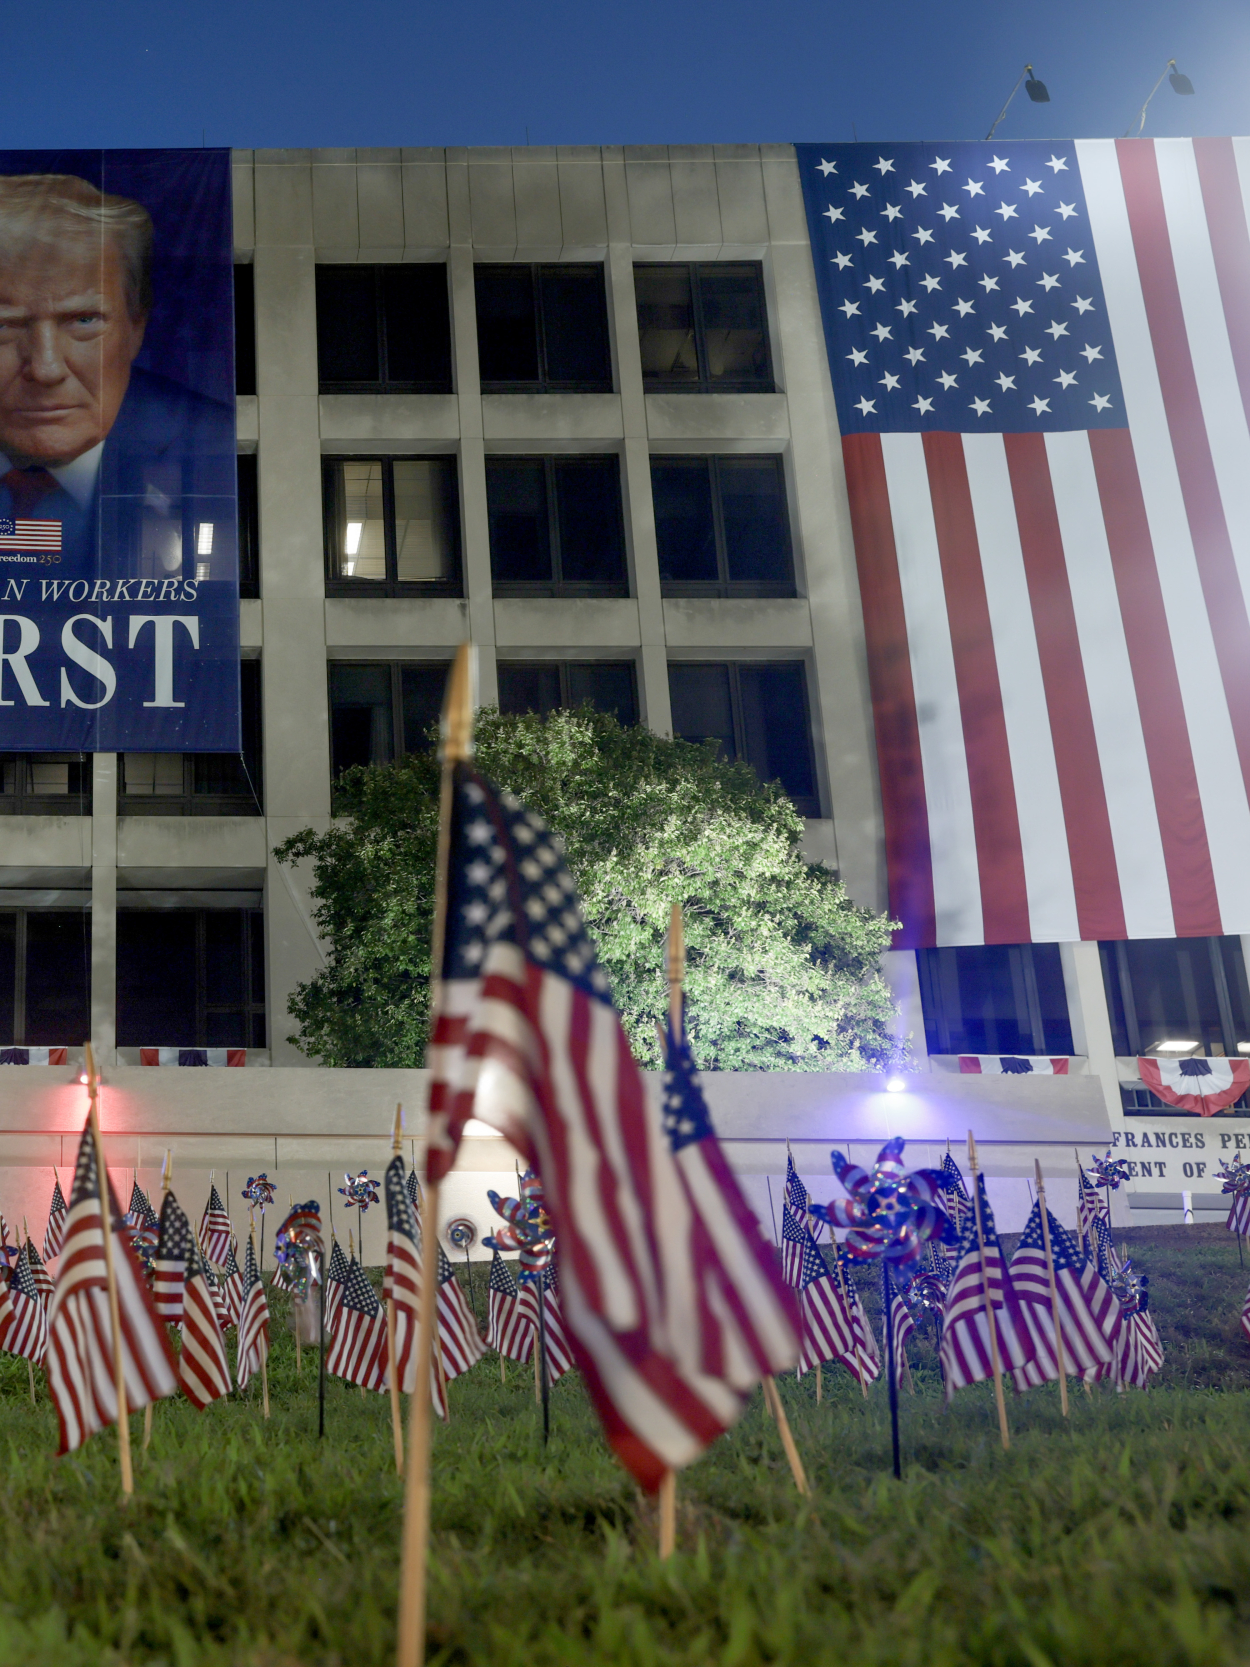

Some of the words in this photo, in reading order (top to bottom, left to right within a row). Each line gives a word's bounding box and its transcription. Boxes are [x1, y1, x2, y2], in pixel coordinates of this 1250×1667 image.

[39, 555, 61, 566] 250
[39, 578, 200, 603] WORKERS
[1112, 1132, 1205, 1149] FRANCES
[1220, 1133, 1250, 1149] PE
[1127, 1162, 1166, 1177] ENT
[1183, 1162, 1206, 1178] OF
